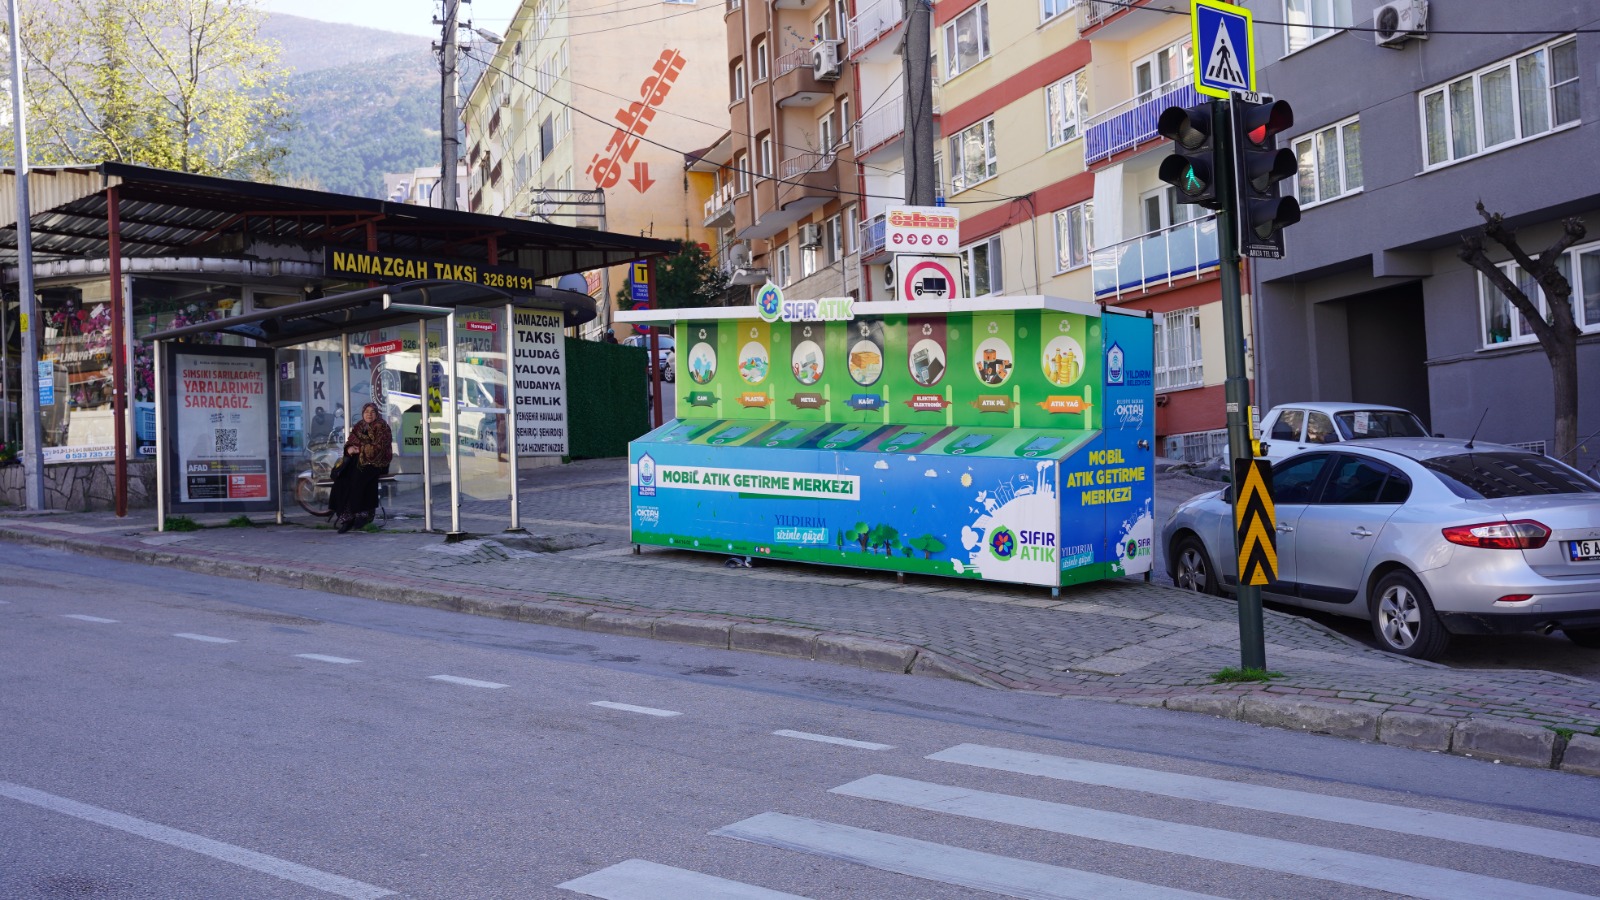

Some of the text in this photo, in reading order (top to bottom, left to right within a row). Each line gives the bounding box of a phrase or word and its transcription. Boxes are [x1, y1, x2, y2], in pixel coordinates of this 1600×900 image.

[1244, 91, 1259, 102] 270
[585, 48, 687, 188] özhan
[889, 212, 957, 229] özhan
[333, 251, 428, 280] NAMAZGAH
[783, 300, 852, 319] SIFIR ATIK
[514, 313, 560, 328] NAMAZGAH
[370, 342, 396, 354] Namazgah
[514, 348, 560, 359] ULUDAĞ
[515, 364, 560, 375] YALOVA
[184, 380, 264, 395] YARALARIMIZI
[515, 380, 561, 390] MUDANYA
[185, 394, 252, 409] SARACAĞIZ.
[1116, 404, 1144, 416] OKTAY
[188, 464, 208, 472] AFAD
[702, 472, 731, 487] ATIK
[1066, 471, 1095, 488] ATIK
[774, 514, 827, 529] YILDIRIM
[801, 527, 826, 544] güzel
[1019, 530, 1056, 547] SIFIR
[1020, 546, 1056, 563] ATIK
[1137, 547, 1151, 557] ATIK
